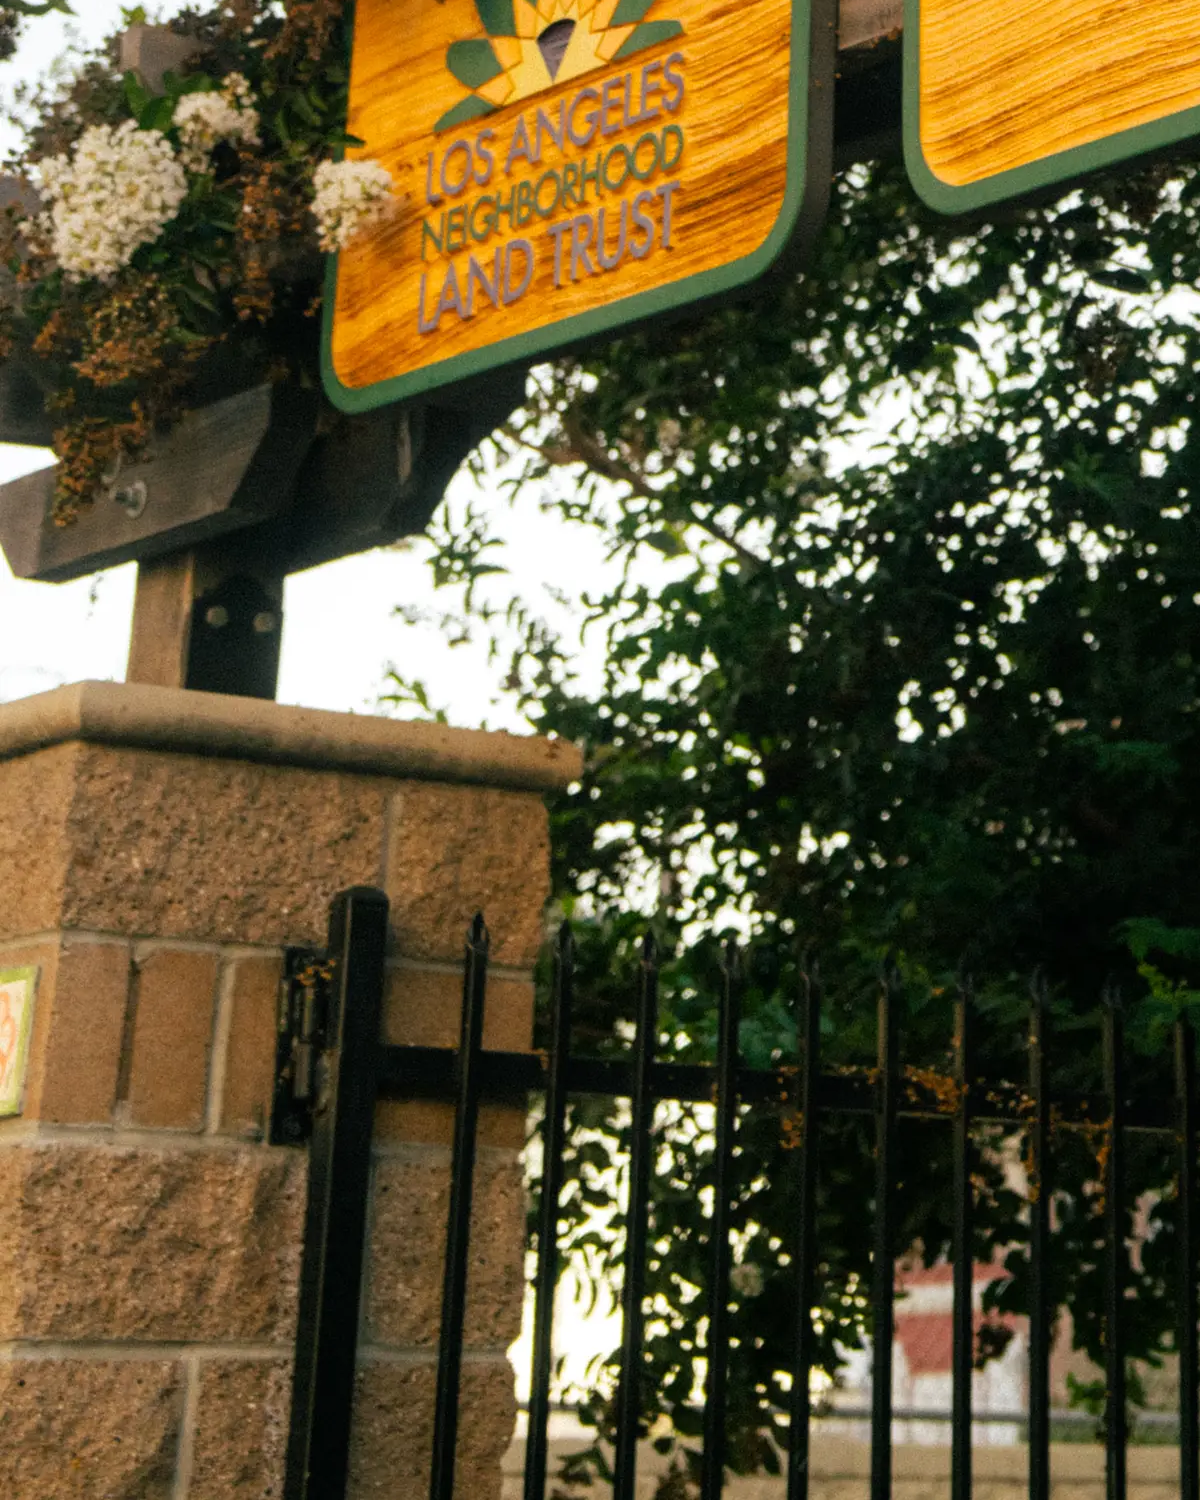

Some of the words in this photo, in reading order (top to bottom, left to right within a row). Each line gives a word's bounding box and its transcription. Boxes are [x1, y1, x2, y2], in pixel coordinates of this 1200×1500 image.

[420, 124, 684, 260] NEIGHBORHOOD
[426, 128, 494, 205] LOS
[504, 51, 685, 173] ANGELES
[418, 238, 534, 334] LAND
[547, 180, 681, 287] TRUST
